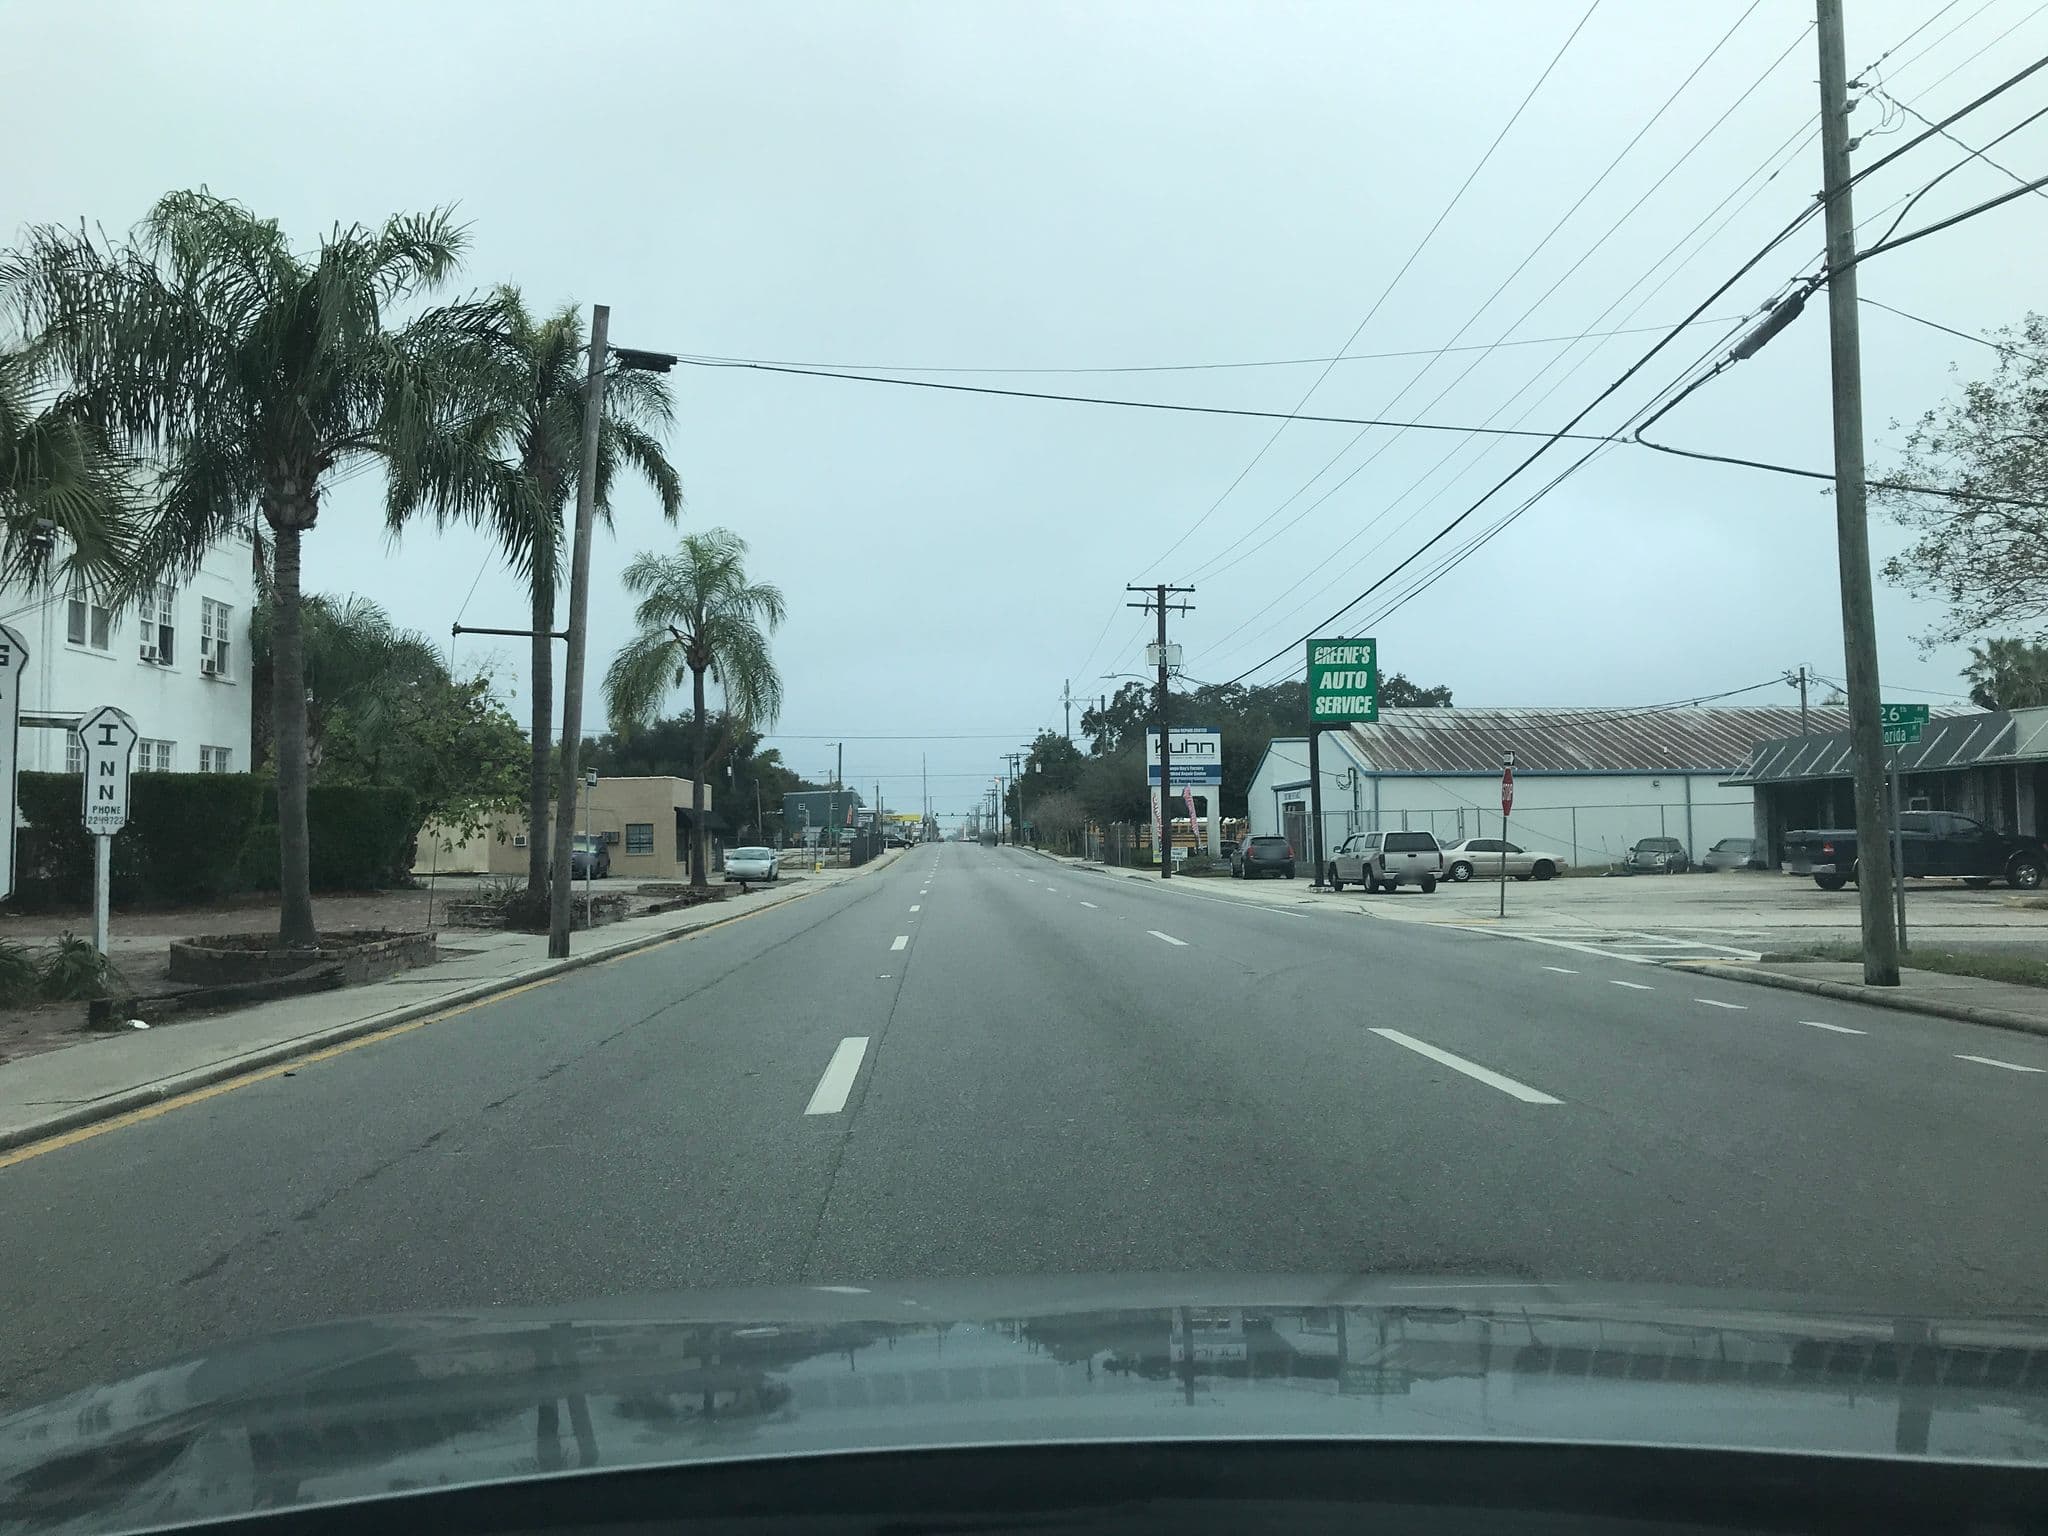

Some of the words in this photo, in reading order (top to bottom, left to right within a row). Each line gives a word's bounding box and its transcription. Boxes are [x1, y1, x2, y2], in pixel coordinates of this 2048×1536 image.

[1315, 646, 1371, 664] GREENE'S
[1319, 671, 1368, 689] AUTO
[1315, 696, 1373, 714] SERVICE
[1884, 727, 1906, 743] orida
[92, 805, 121, 815] PHONE
